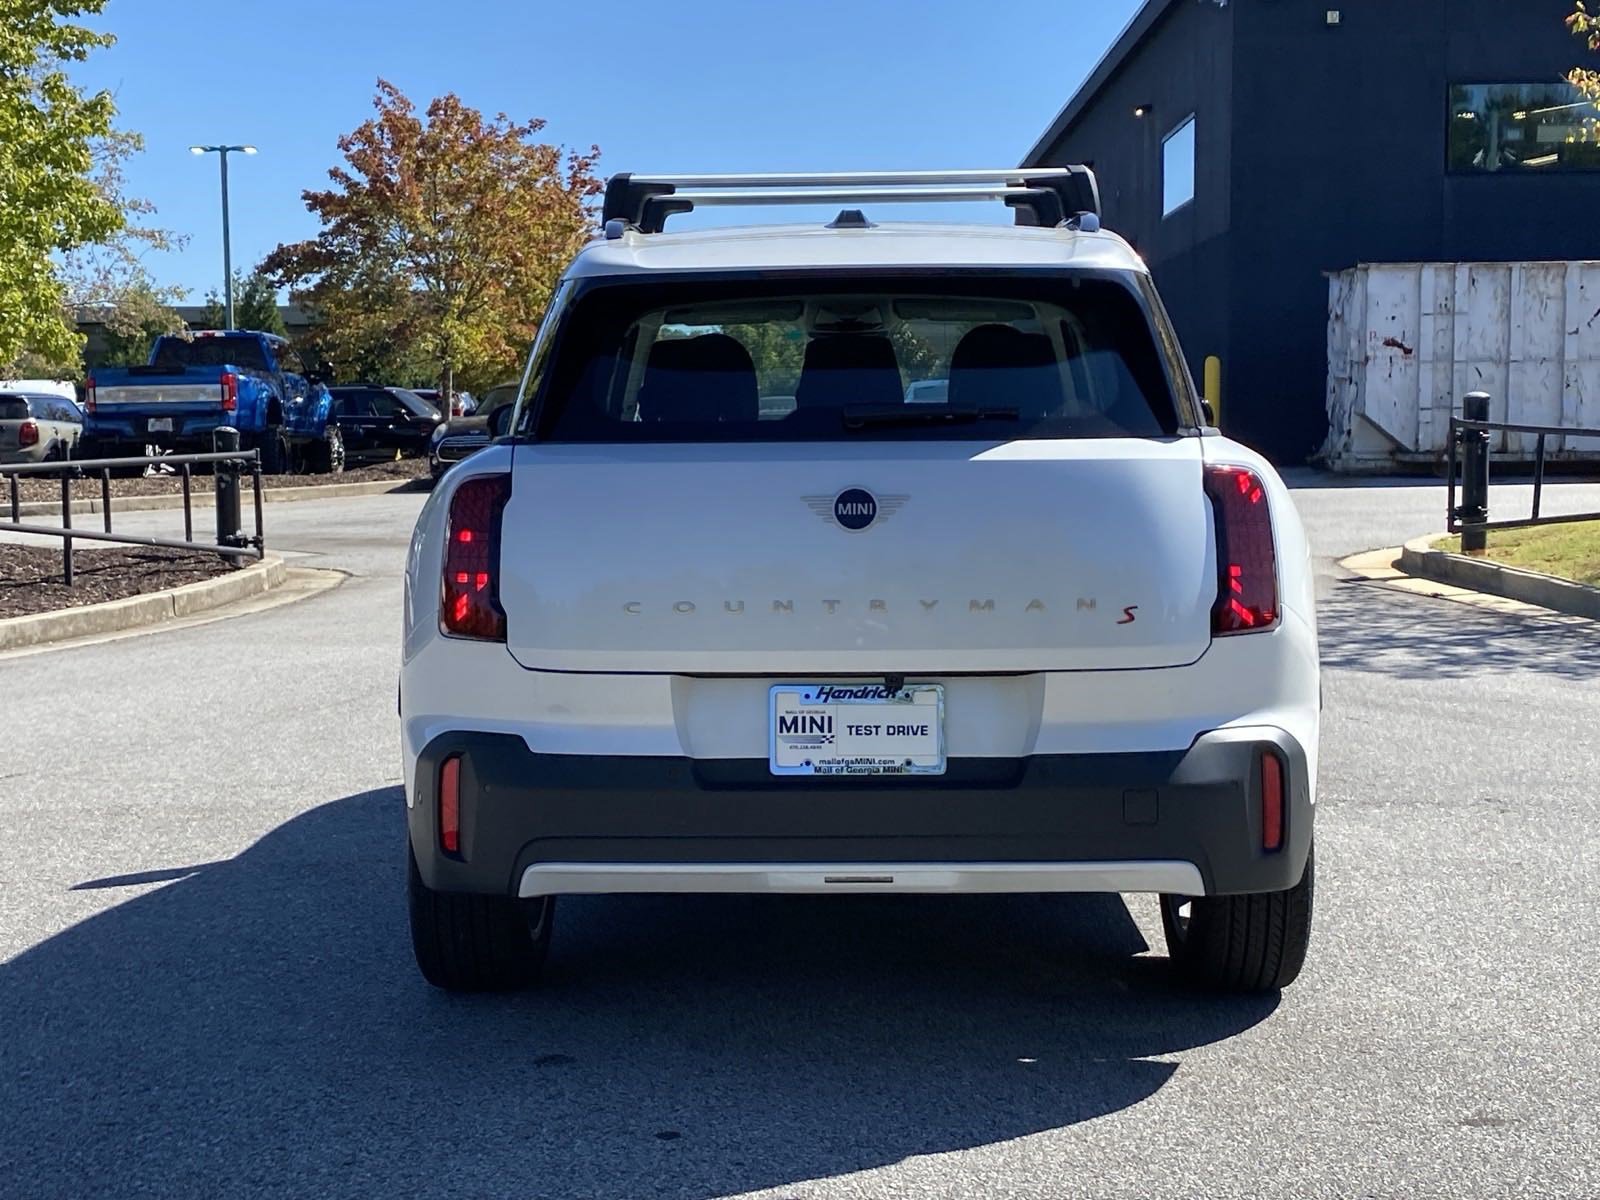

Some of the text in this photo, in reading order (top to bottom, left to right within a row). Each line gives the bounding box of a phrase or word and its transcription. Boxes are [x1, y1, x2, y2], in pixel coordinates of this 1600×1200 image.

[838, 502, 873, 515] MINI
[623, 598, 1138, 625] COUNTRYMAN S
[815, 686, 897, 703] Hendrick
[779, 715, 832, 734] MINI
[846, 724, 929, 736] TEST DRIVE
[814, 764, 903, 776] Mall of Georgia MINI
